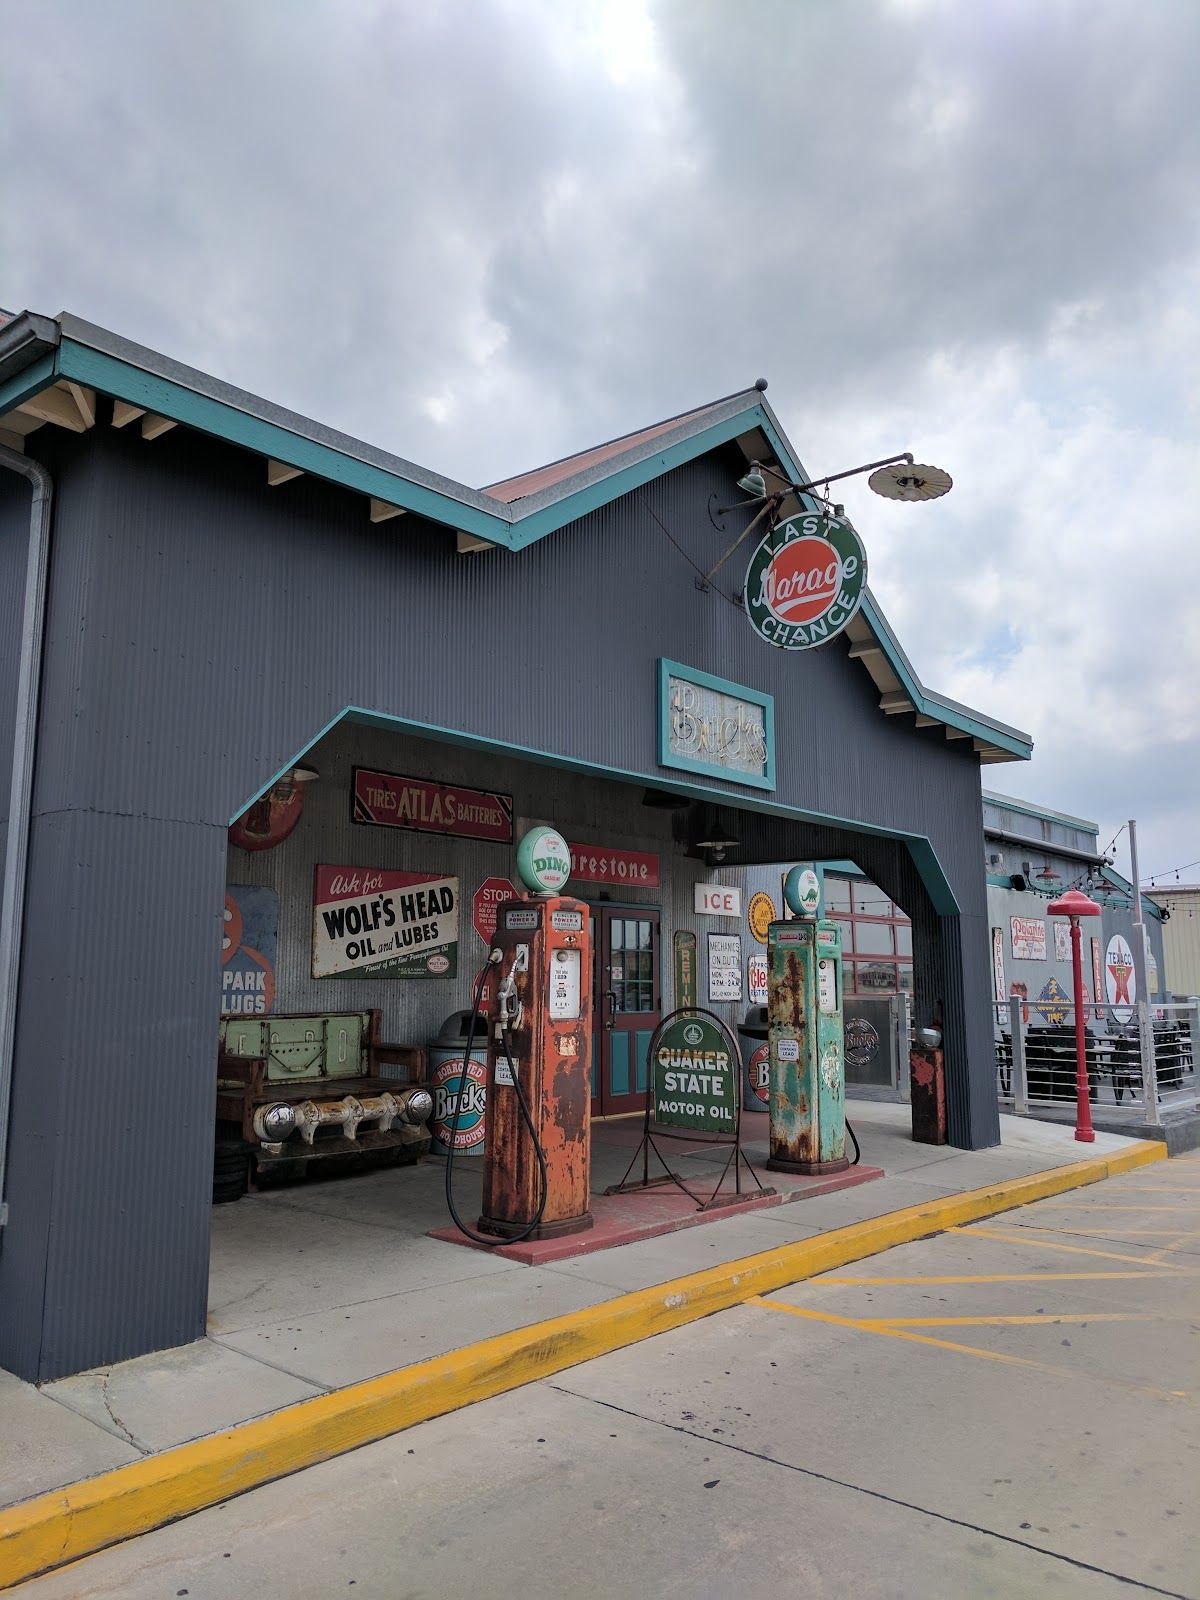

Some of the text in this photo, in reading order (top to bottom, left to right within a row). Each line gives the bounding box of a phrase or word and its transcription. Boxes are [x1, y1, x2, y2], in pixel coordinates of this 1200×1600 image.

[762, 517, 840, 556] LAST
[751, 555, 858, 607] Garage
[761, 590, 855, 645] CHANCE
[366, 786, 503, 827] TIRES ATLAS BATTERIES
[533, 857, 569, 875] DINO
[571, 849, 648, 879] irestone
[329, 872, 384, 895] Ask for
[483, 888, 512, 901] STOP!
[322, 886, 454, 940] WOLF'S HEAD
[703, 893, 733, 911] ICE
[345, 921, 439, 960] OIL and LUBES
[710, 941, 740, 953] MECHANICS
[712, 955, 739, 966] ON DUTY
[1108, 951, 1132, 966] TEXACO
[222, 971, 266, 991] PARK
[681, 949, 691, 1017] REMING
[750, 968, 767, 988] Cle
[221, 994, 265, 1014] LUGS
[658, 1046, 729, 1072] QUAKER
[664, 1071, 724, 1096] STATE
[658, 1099, 732, 1120] MOTOR OIL
